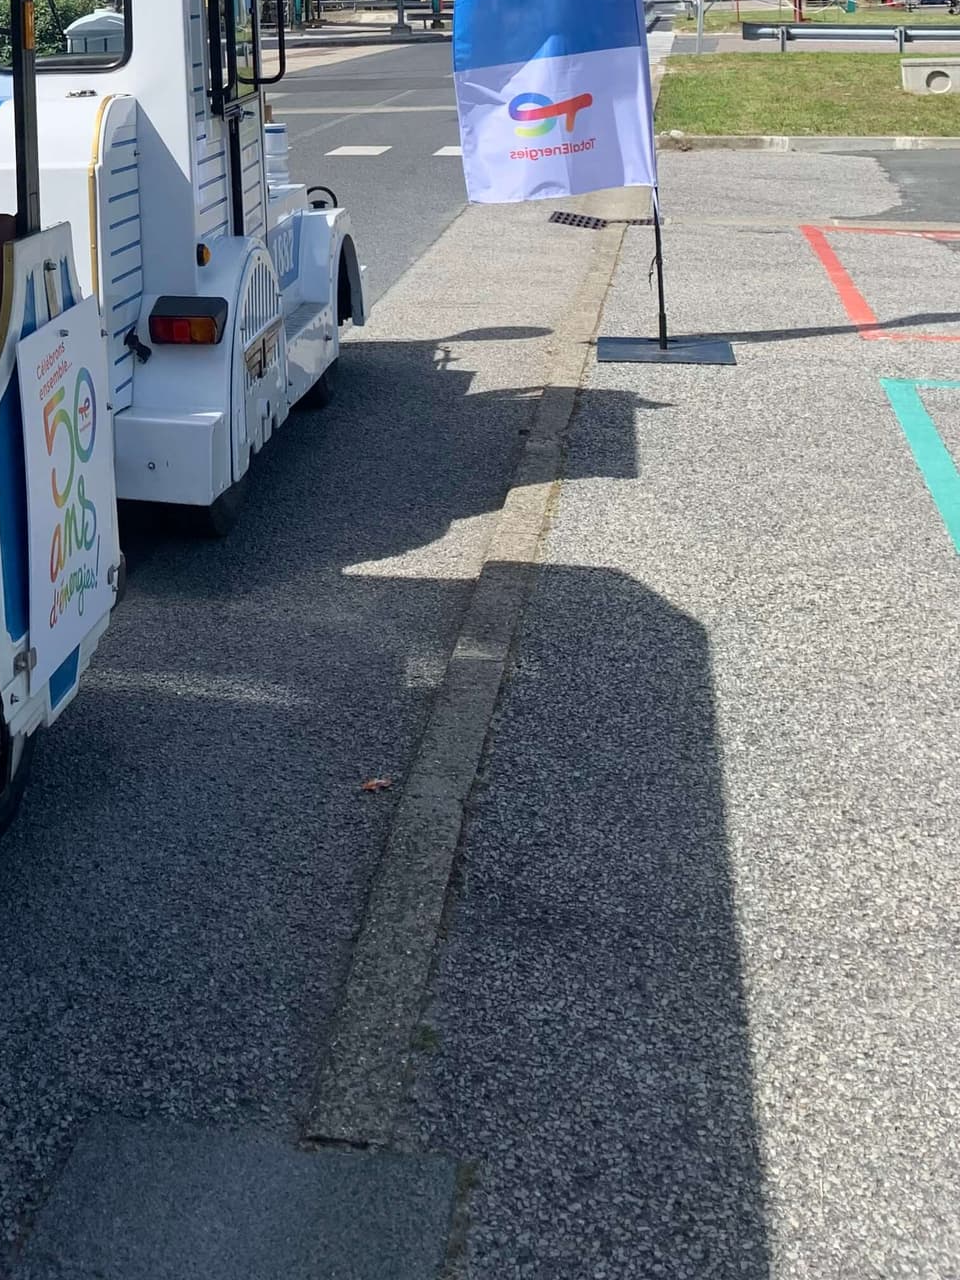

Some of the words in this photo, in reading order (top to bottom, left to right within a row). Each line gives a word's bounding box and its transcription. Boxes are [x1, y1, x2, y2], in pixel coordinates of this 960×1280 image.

[36, 340, 66, 381] Célébrons
[42, 366, 97, 509] 50
[49, 474, 97, 584] ans
